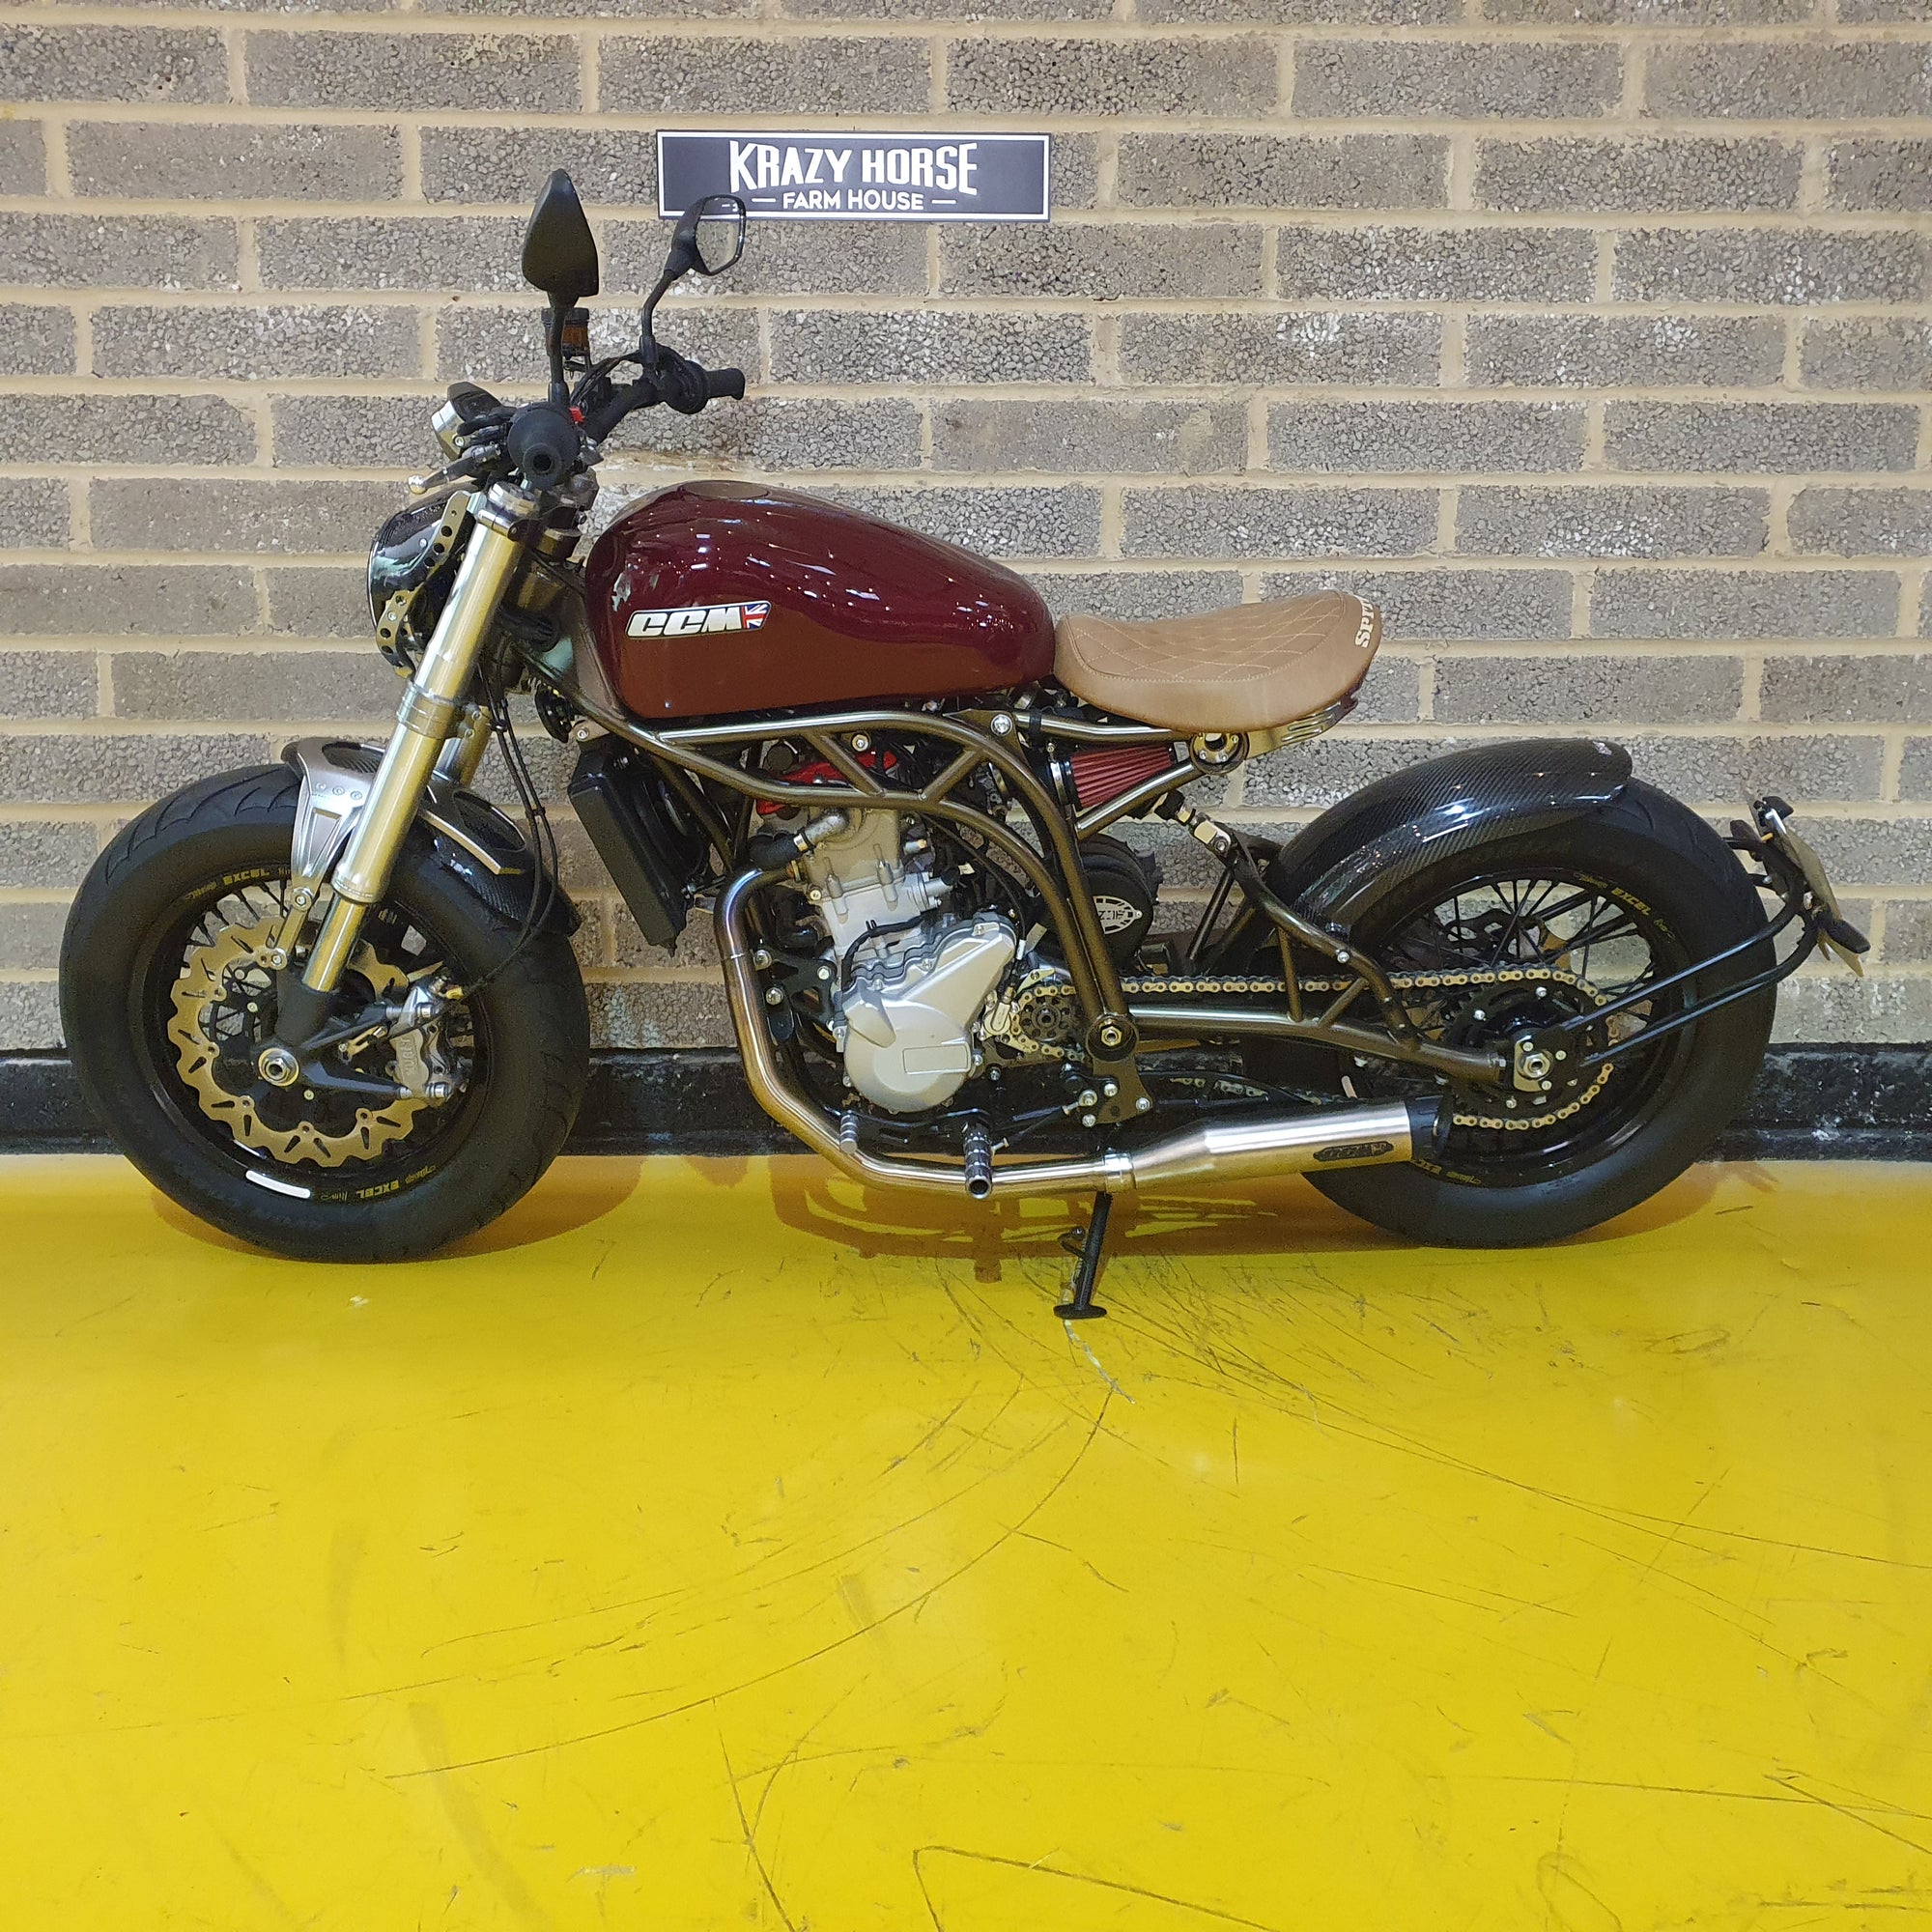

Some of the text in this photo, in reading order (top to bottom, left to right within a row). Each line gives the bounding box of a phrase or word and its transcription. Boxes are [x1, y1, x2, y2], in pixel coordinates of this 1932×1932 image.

[729, 140, 978, 196] KRAZY HORSE
[782, 189, 924, 211] FARM HOUSE
[627, 606, 742, 637] CCM
[1610, 887, 1652, 916] EXCEL
